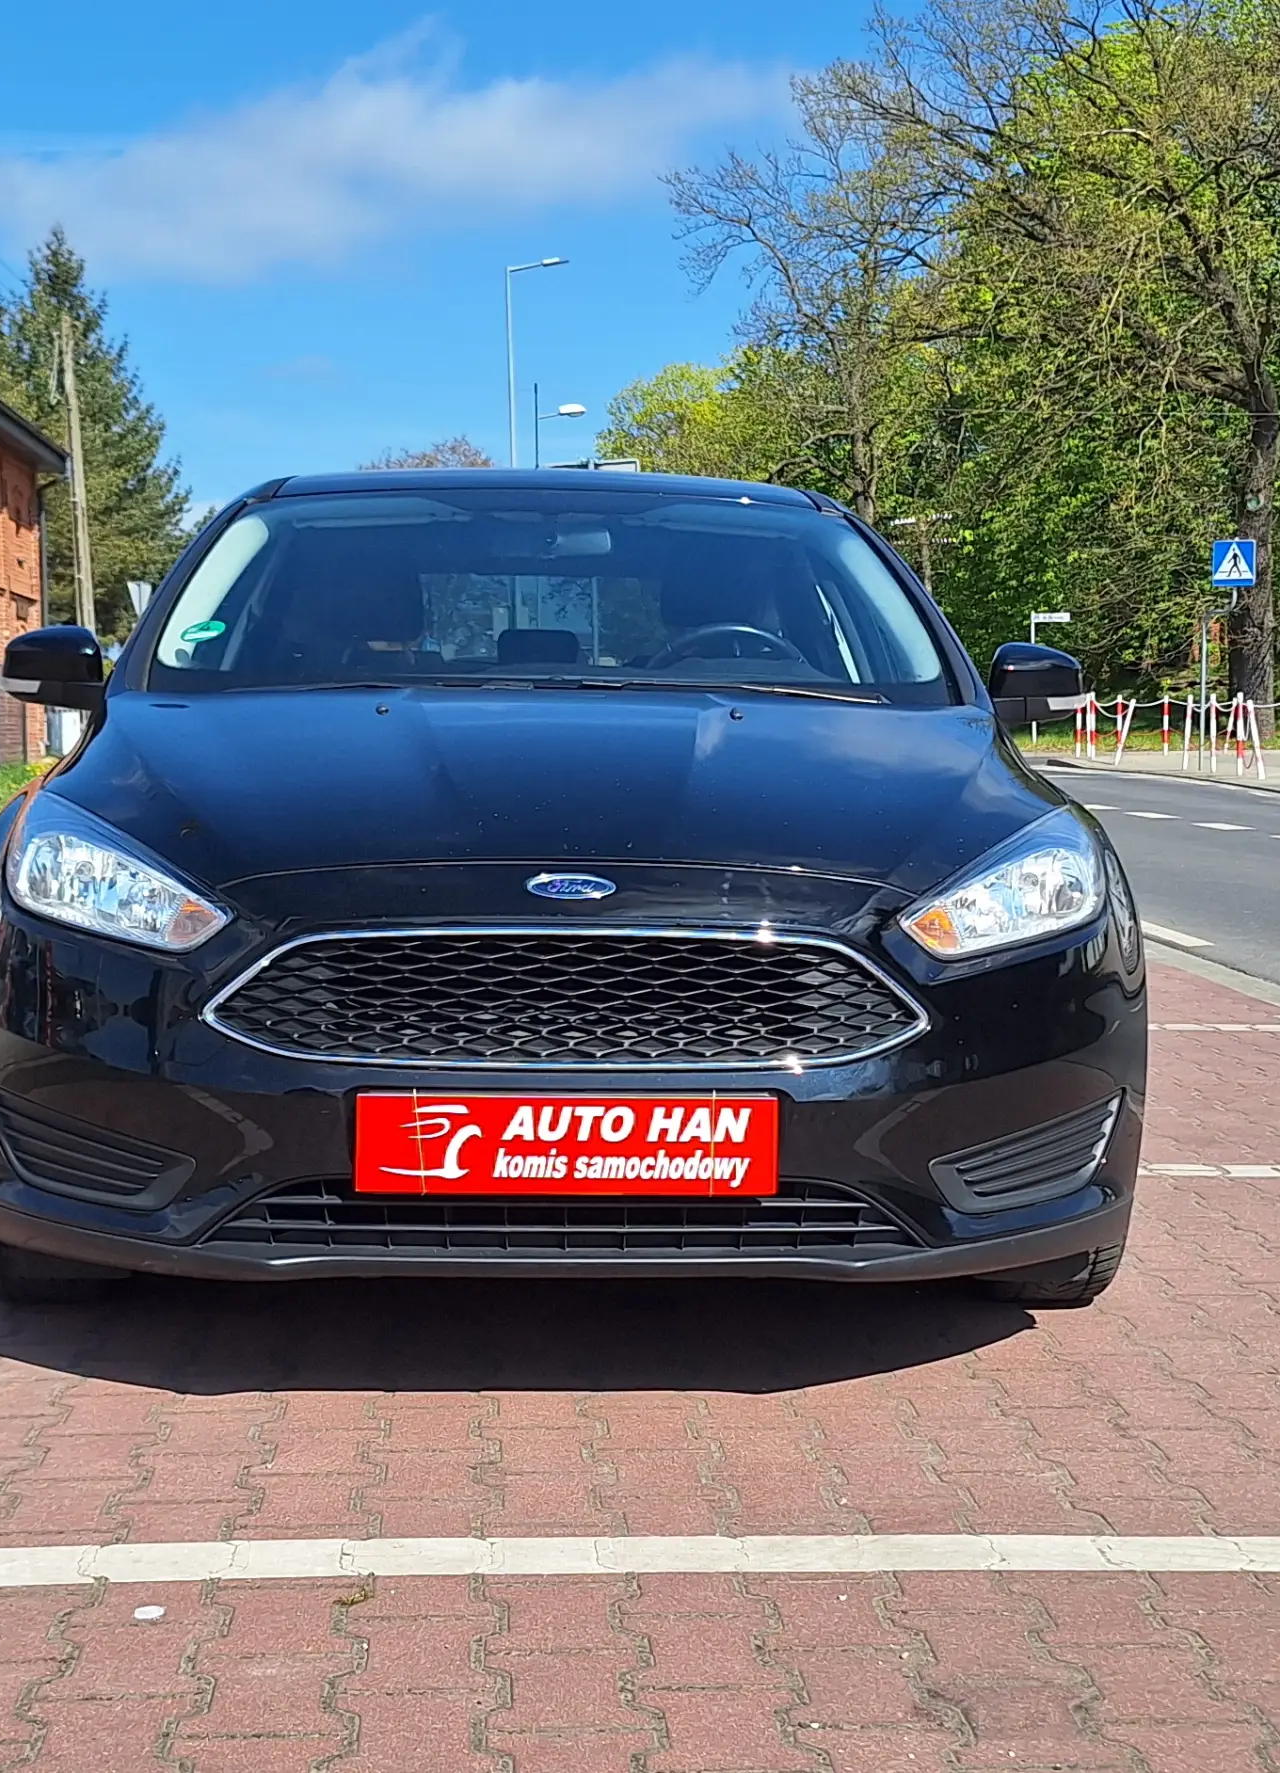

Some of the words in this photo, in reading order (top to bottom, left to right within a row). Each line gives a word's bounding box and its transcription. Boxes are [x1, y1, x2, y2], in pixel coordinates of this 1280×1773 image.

[546, 878, 596, 893] Ford
[501, 1105, 635, 1143] AUTO
[646, 1105, 752, 1143] HAN
[492, 1147, 568, 1179] komis
[573, 1150, 751, 1189] samochodowy
